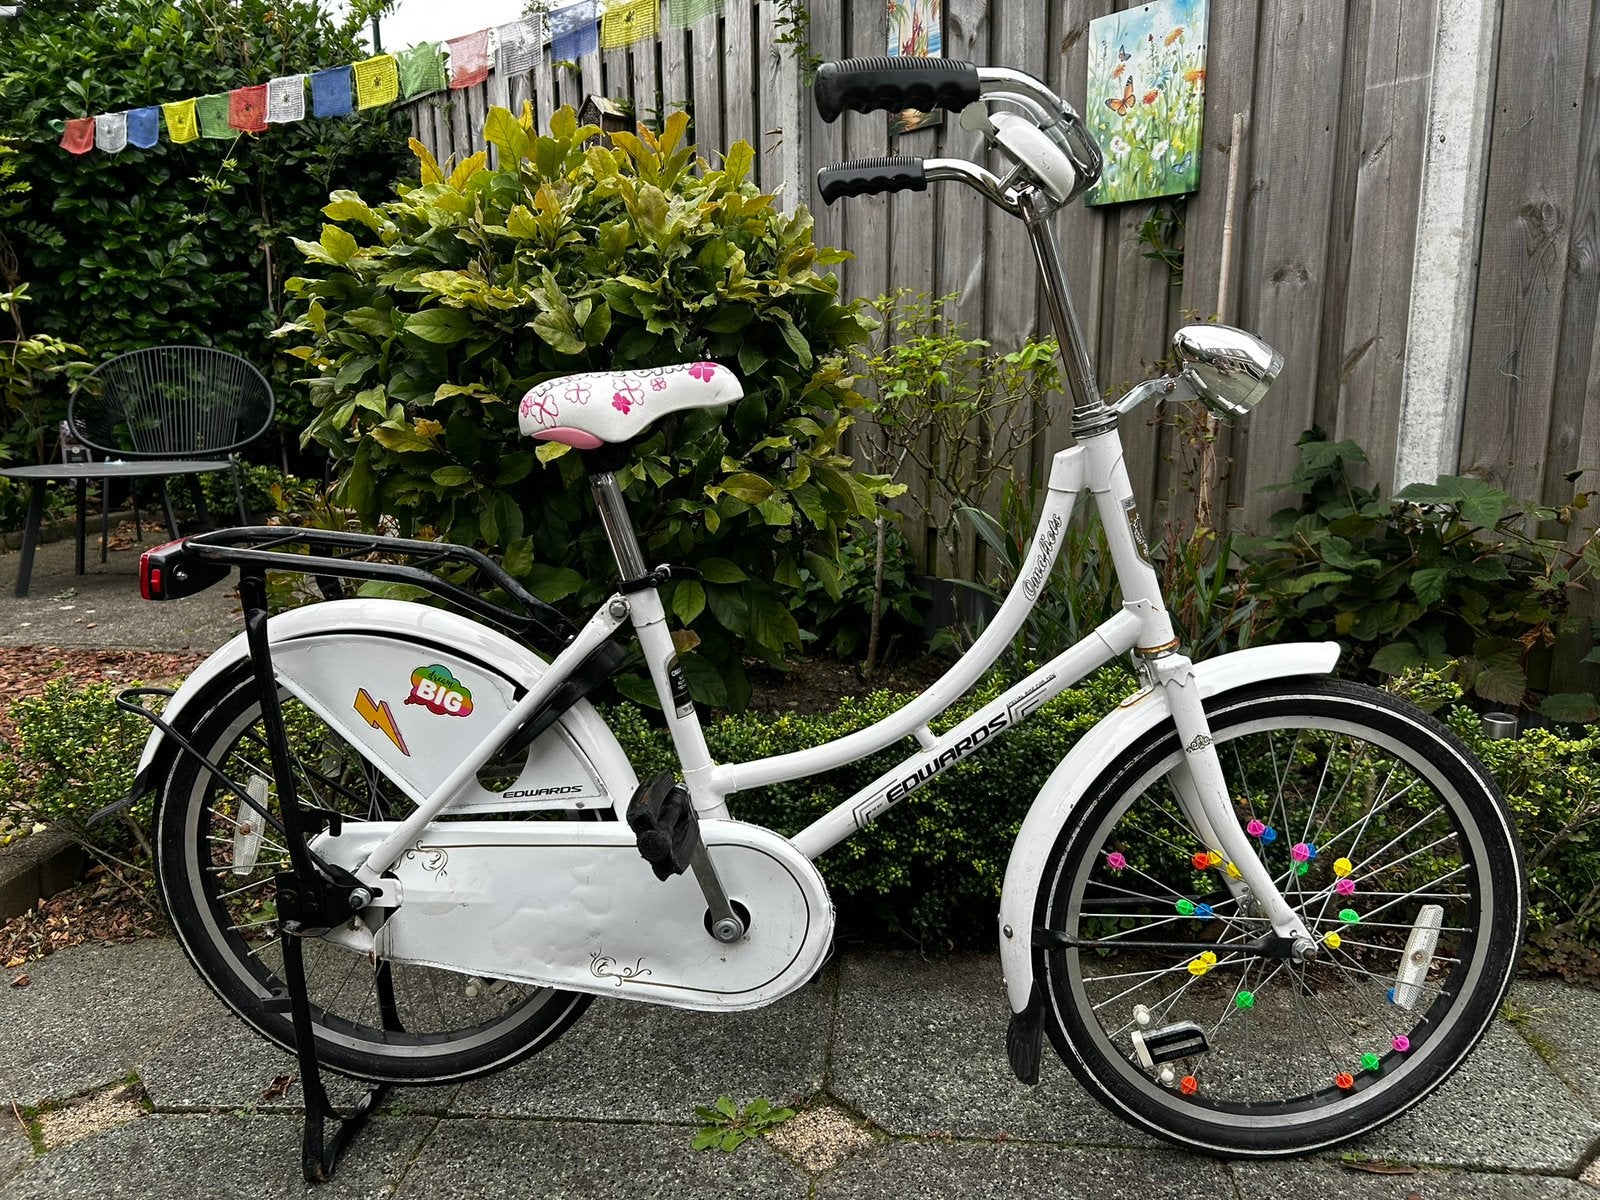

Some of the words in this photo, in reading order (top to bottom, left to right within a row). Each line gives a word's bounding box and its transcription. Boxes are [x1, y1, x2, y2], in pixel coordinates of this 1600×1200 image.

[427, 670, 455, 689] dream
[416, 678, 464, 712] BIG
[886, 712, 1008, 803] EDWARDS
[503, 786, 583, 799] EDWARDS
